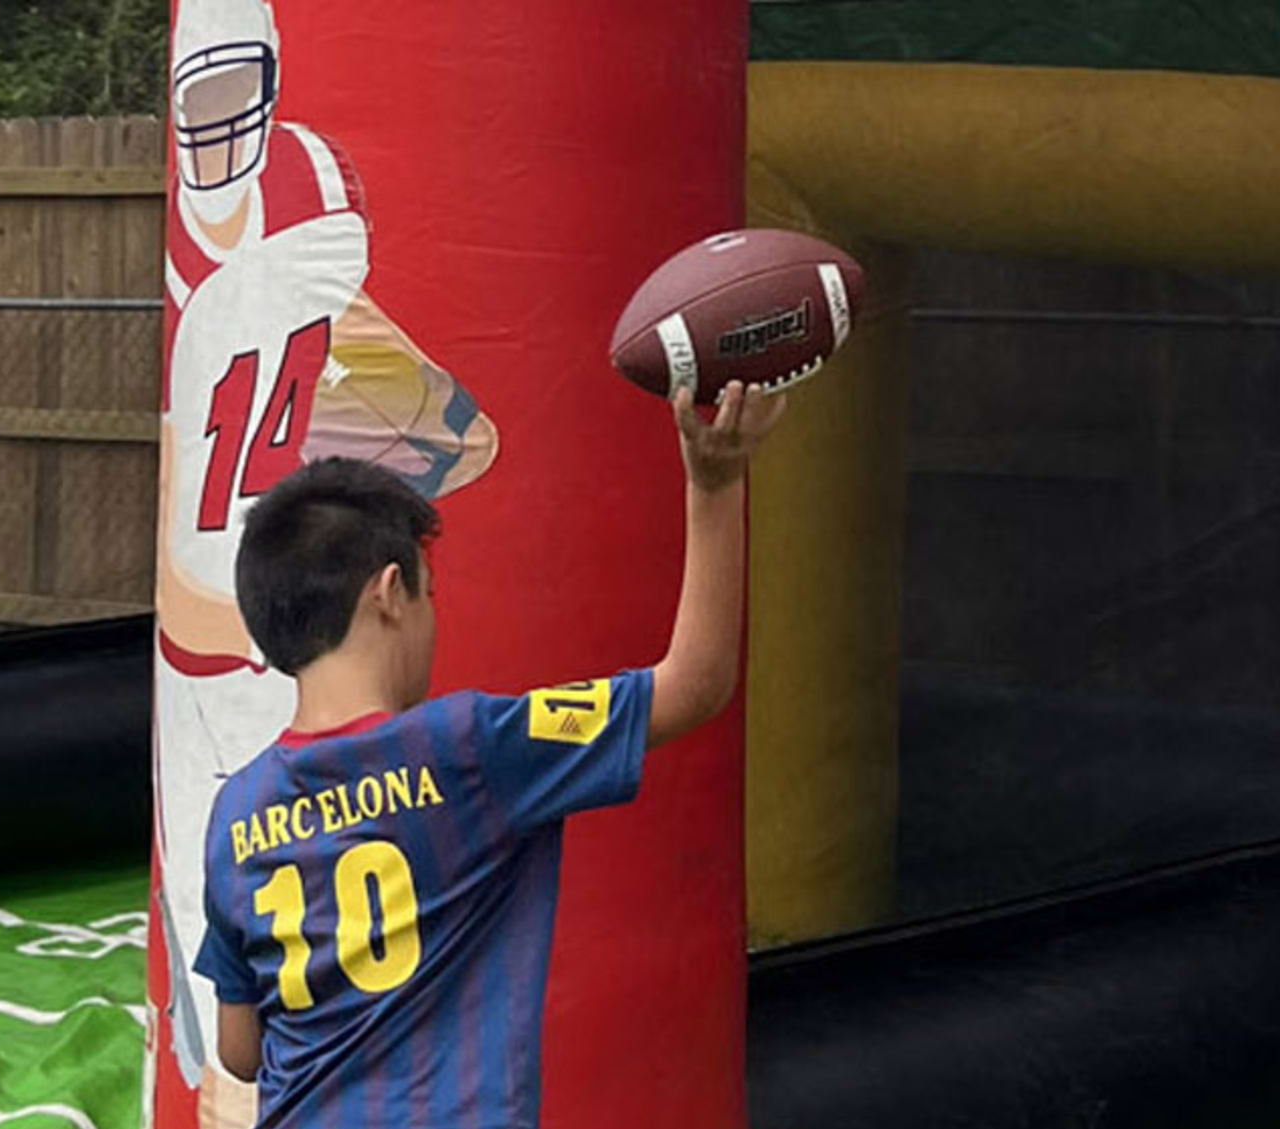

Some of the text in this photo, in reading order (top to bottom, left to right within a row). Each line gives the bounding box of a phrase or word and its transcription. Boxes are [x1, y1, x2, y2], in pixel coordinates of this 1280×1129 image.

[197, 315, 331, 532] 14
[230, 765, 445, 866] BARCELONA
[253, 840, 422, 1012] 10
